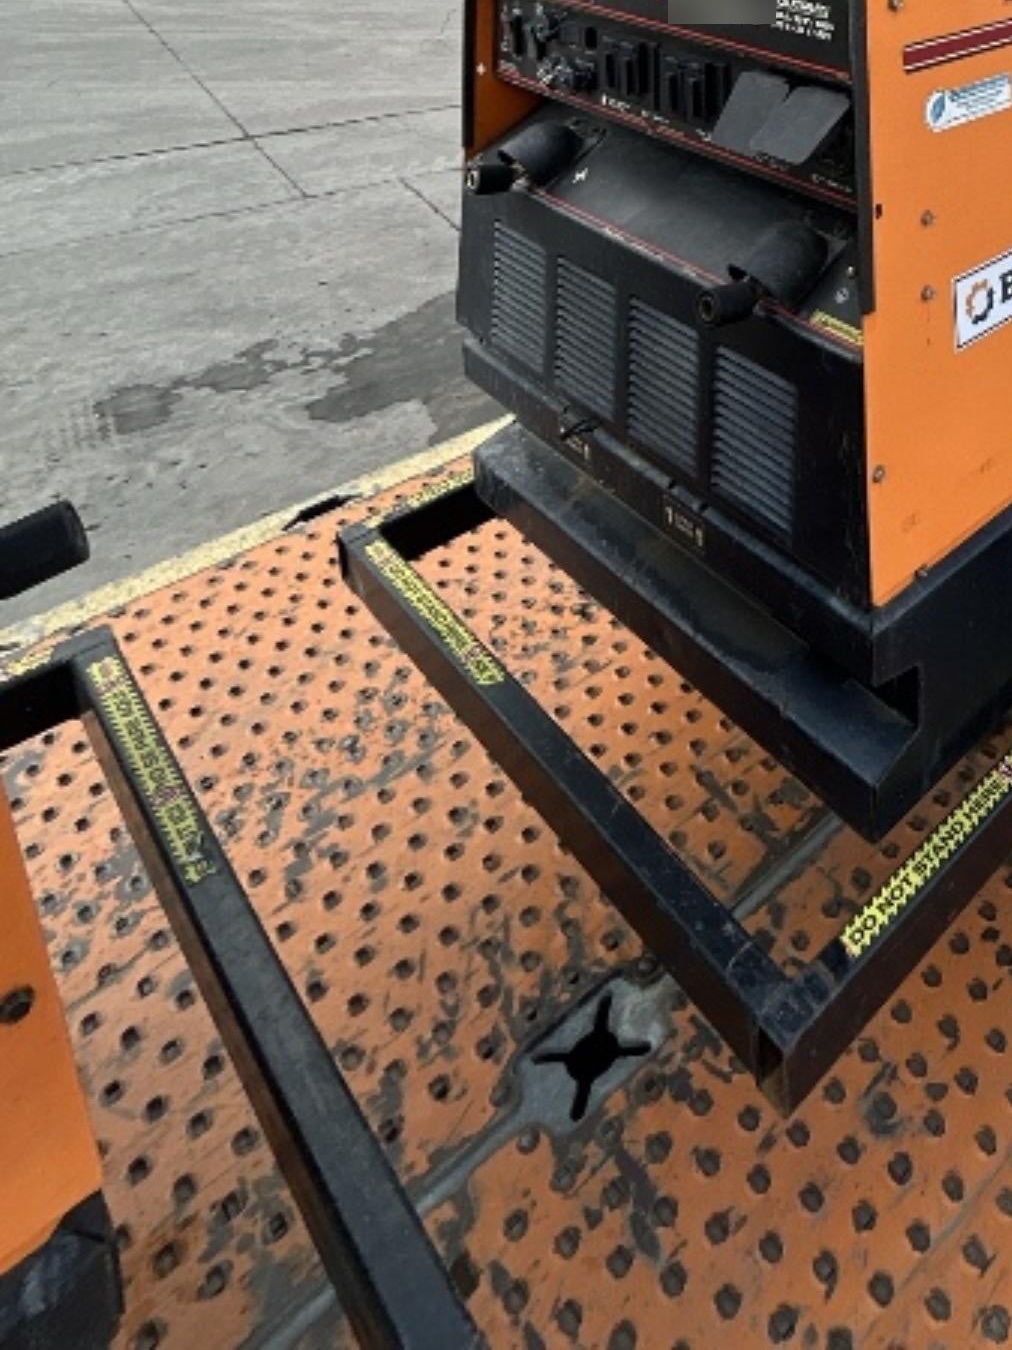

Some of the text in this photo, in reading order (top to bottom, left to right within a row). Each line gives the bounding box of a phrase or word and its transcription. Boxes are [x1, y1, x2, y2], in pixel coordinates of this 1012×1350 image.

[847, 913, 879, 945] DO
[875, 874, 916, 915] NOT
[909, 819, 967, 876] STAND
